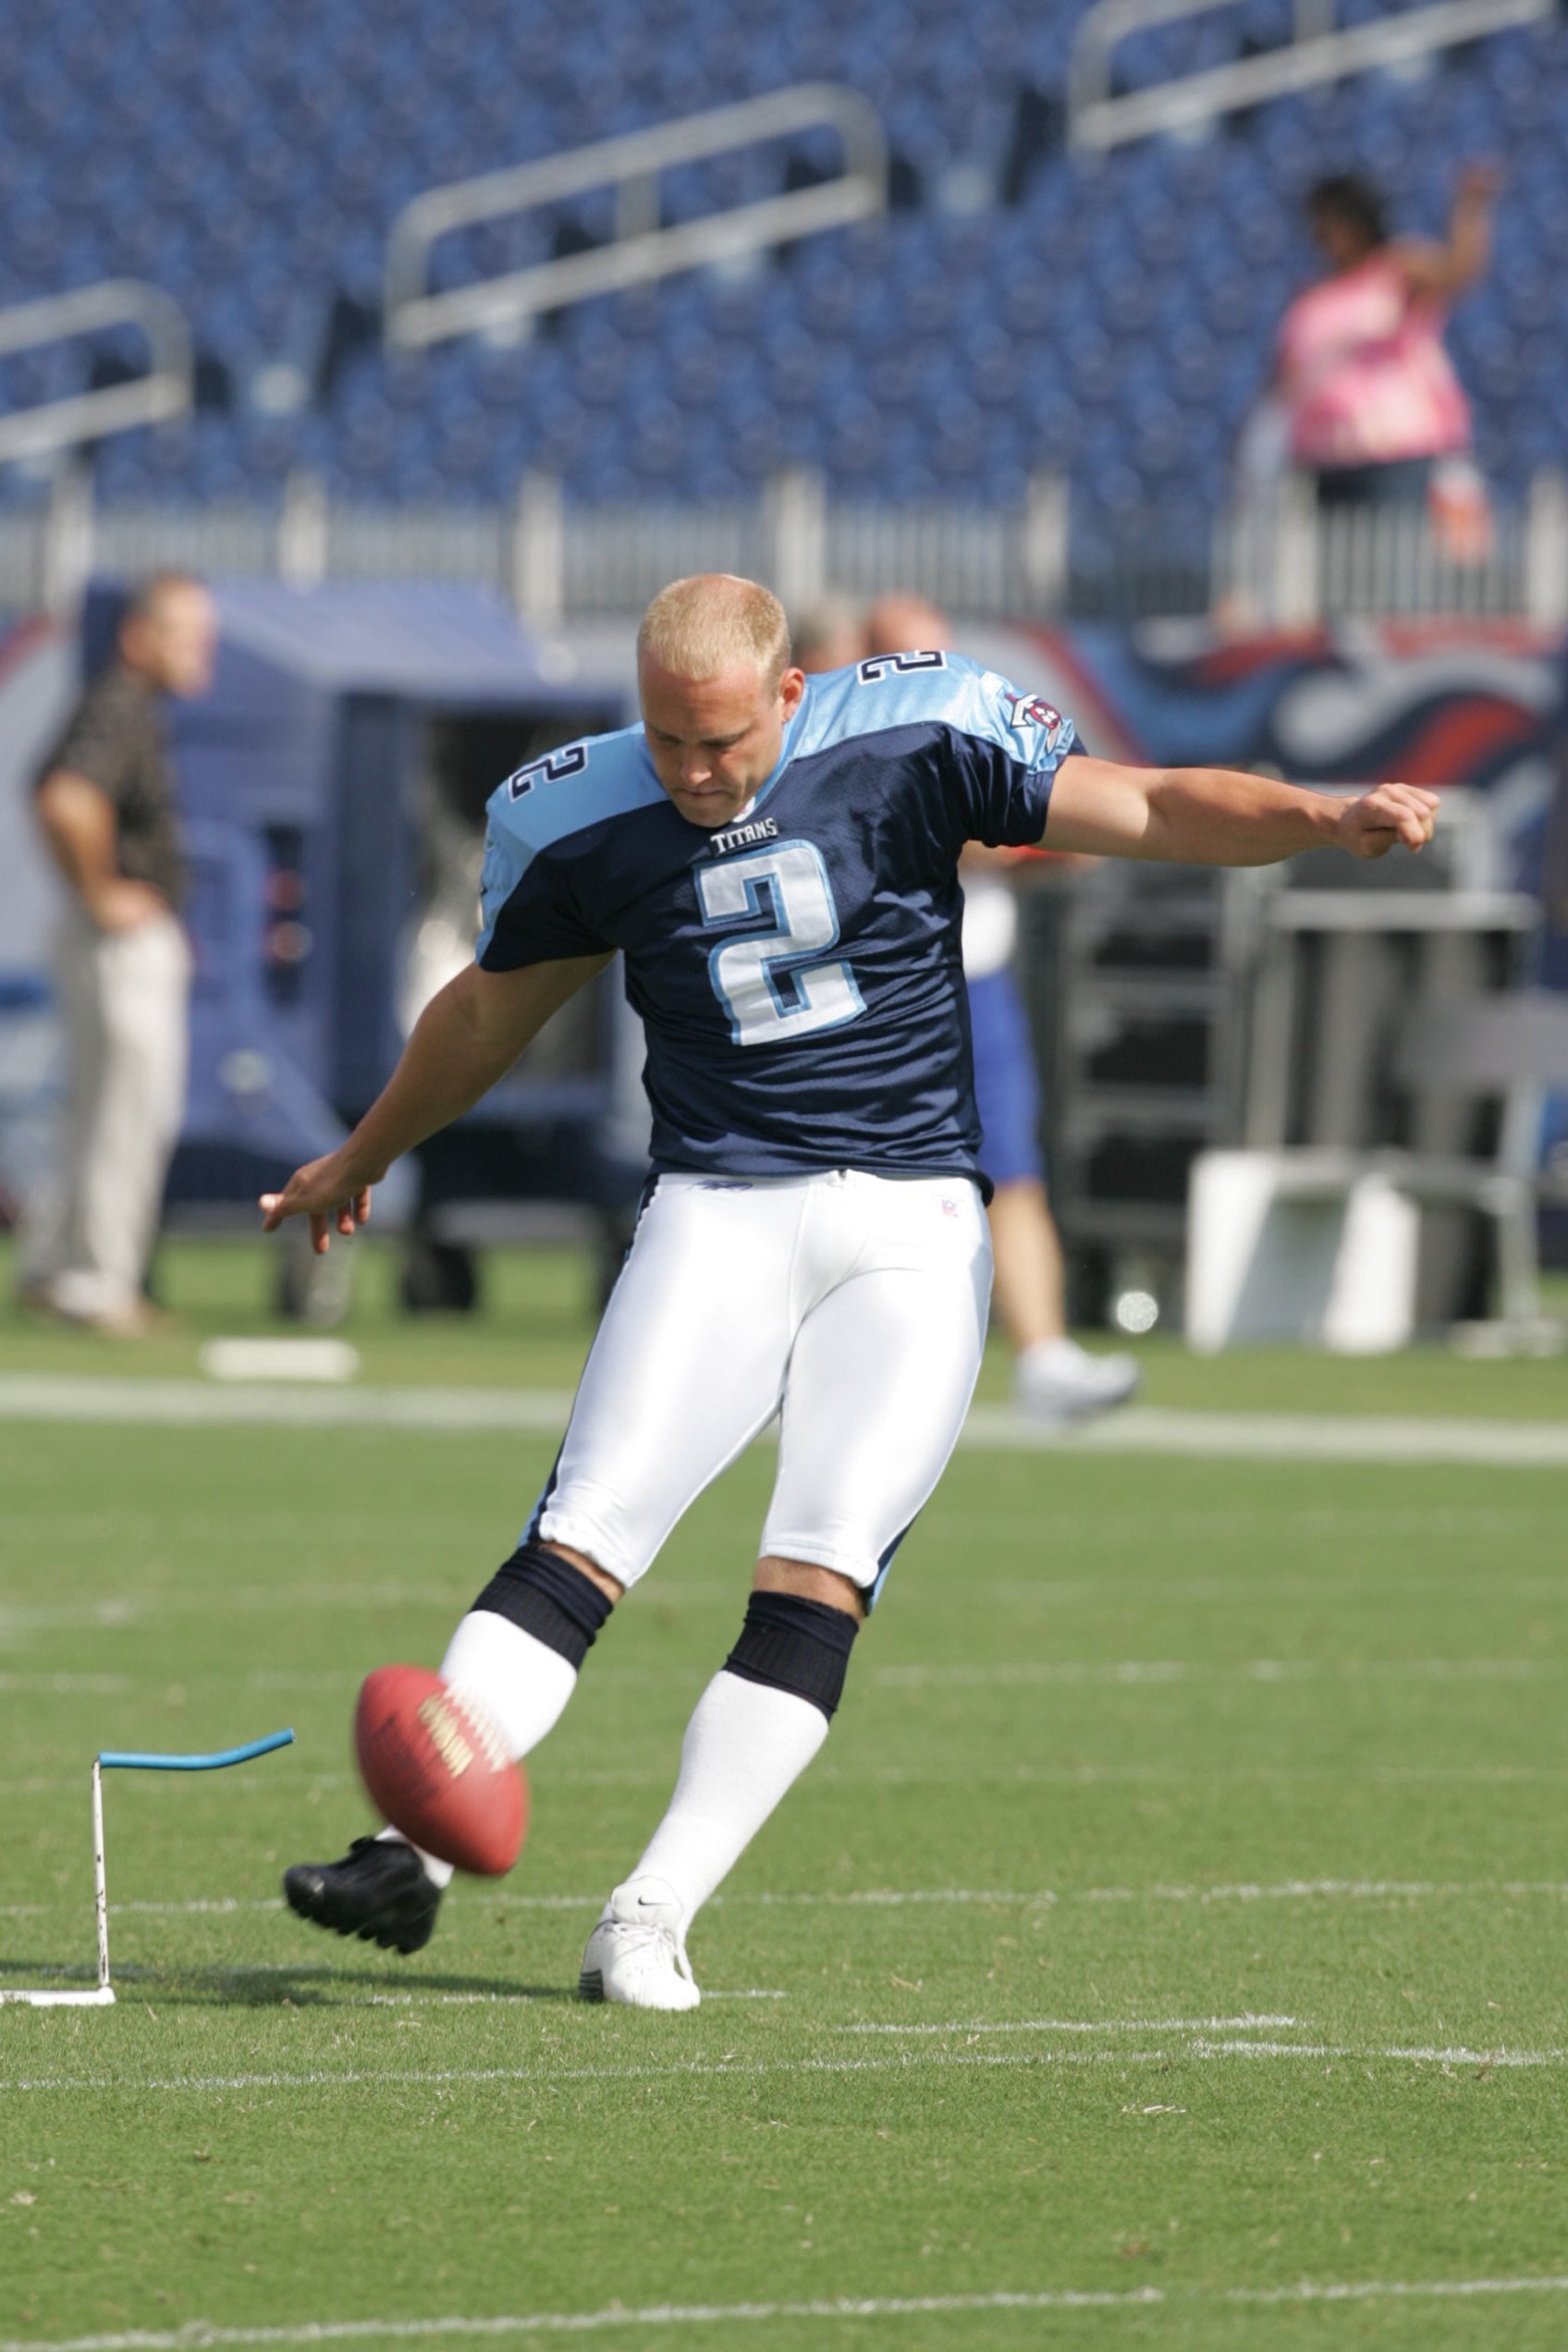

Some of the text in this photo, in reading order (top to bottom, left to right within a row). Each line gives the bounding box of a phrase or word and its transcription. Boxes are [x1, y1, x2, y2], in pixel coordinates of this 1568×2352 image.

[857, 650, 947, 686] 2
[508, 742, 588, 803] 2
[710, 817, 778, 853] TITANS
[693, 839, 867, 1046] 2
